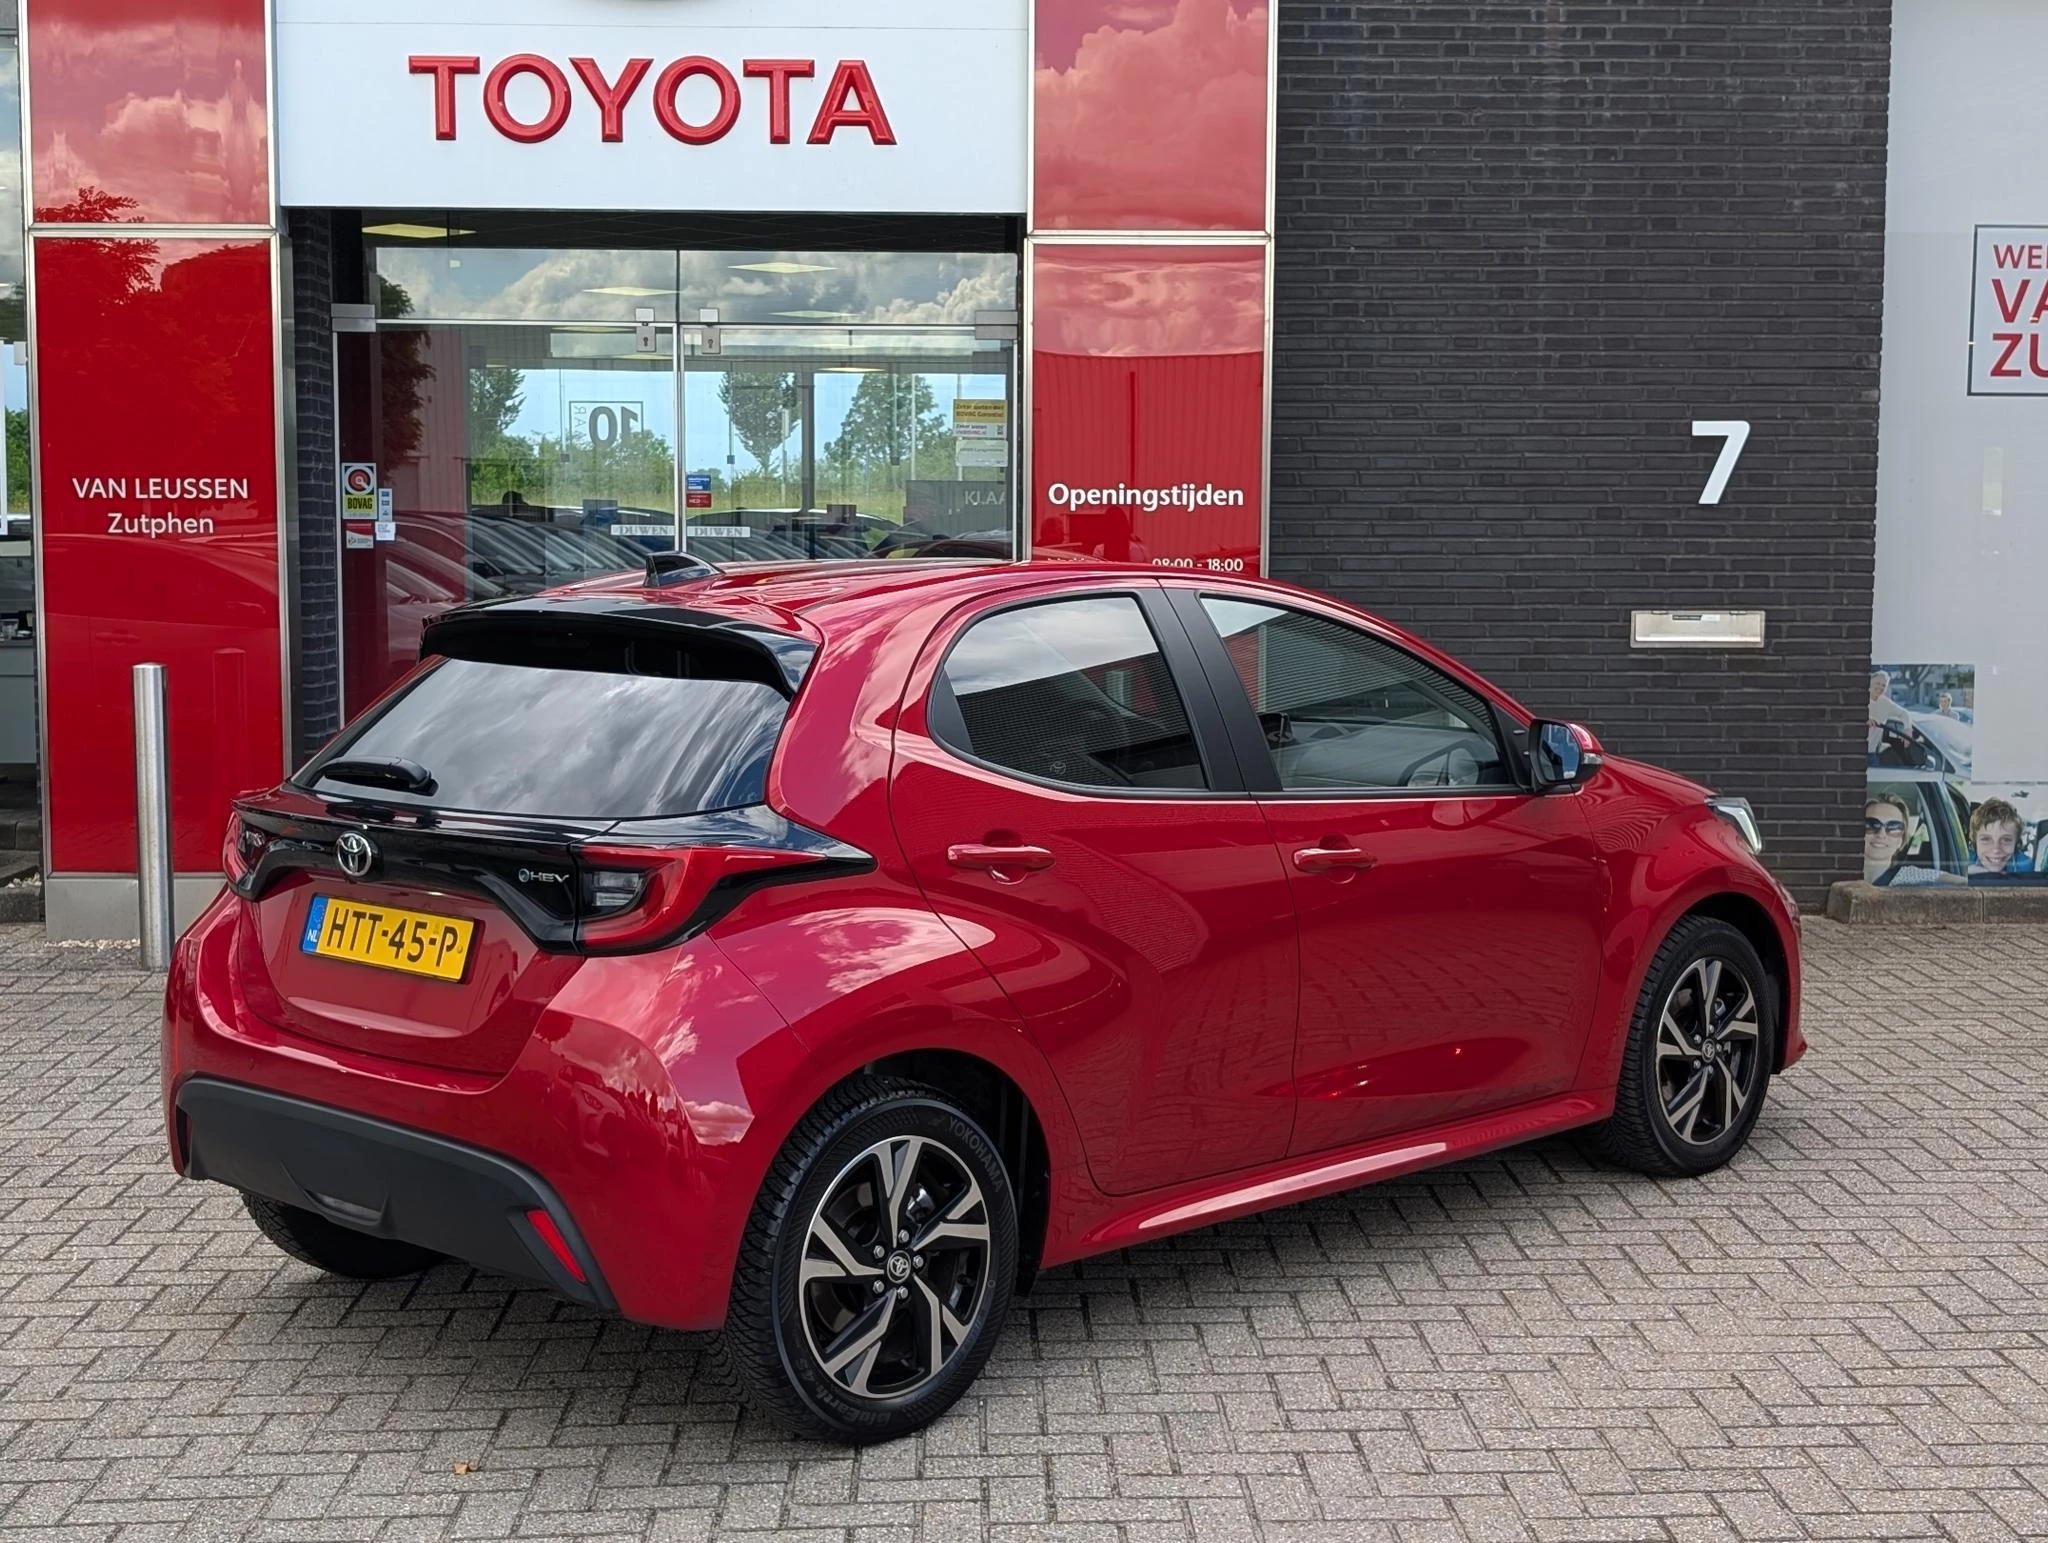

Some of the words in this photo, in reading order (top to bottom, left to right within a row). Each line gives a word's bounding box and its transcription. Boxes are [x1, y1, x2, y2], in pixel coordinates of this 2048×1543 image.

[408, 53, 897, 145] TOYOTA
[1992, 244, 2048, 270] WE
[1691, 420, 1751, 505] 7
[72, 478, 126, 499] VAN
[135, 478, 248, 499] LEUSSEN
[1048, 483, 1244, 512] Openingstijden
[347, 496, 373, 510] BOVAG
[107, 512, 214, 539] Zutphen
[1207, 558, 1244, 572] 18:00
[530, 871, 570, 882] HEV
[307, 929, 318, 942] NL
[327, 907, 459, 967] HTT-45-P
[949, 1115, 1004, 1193] YOKOHAMA
